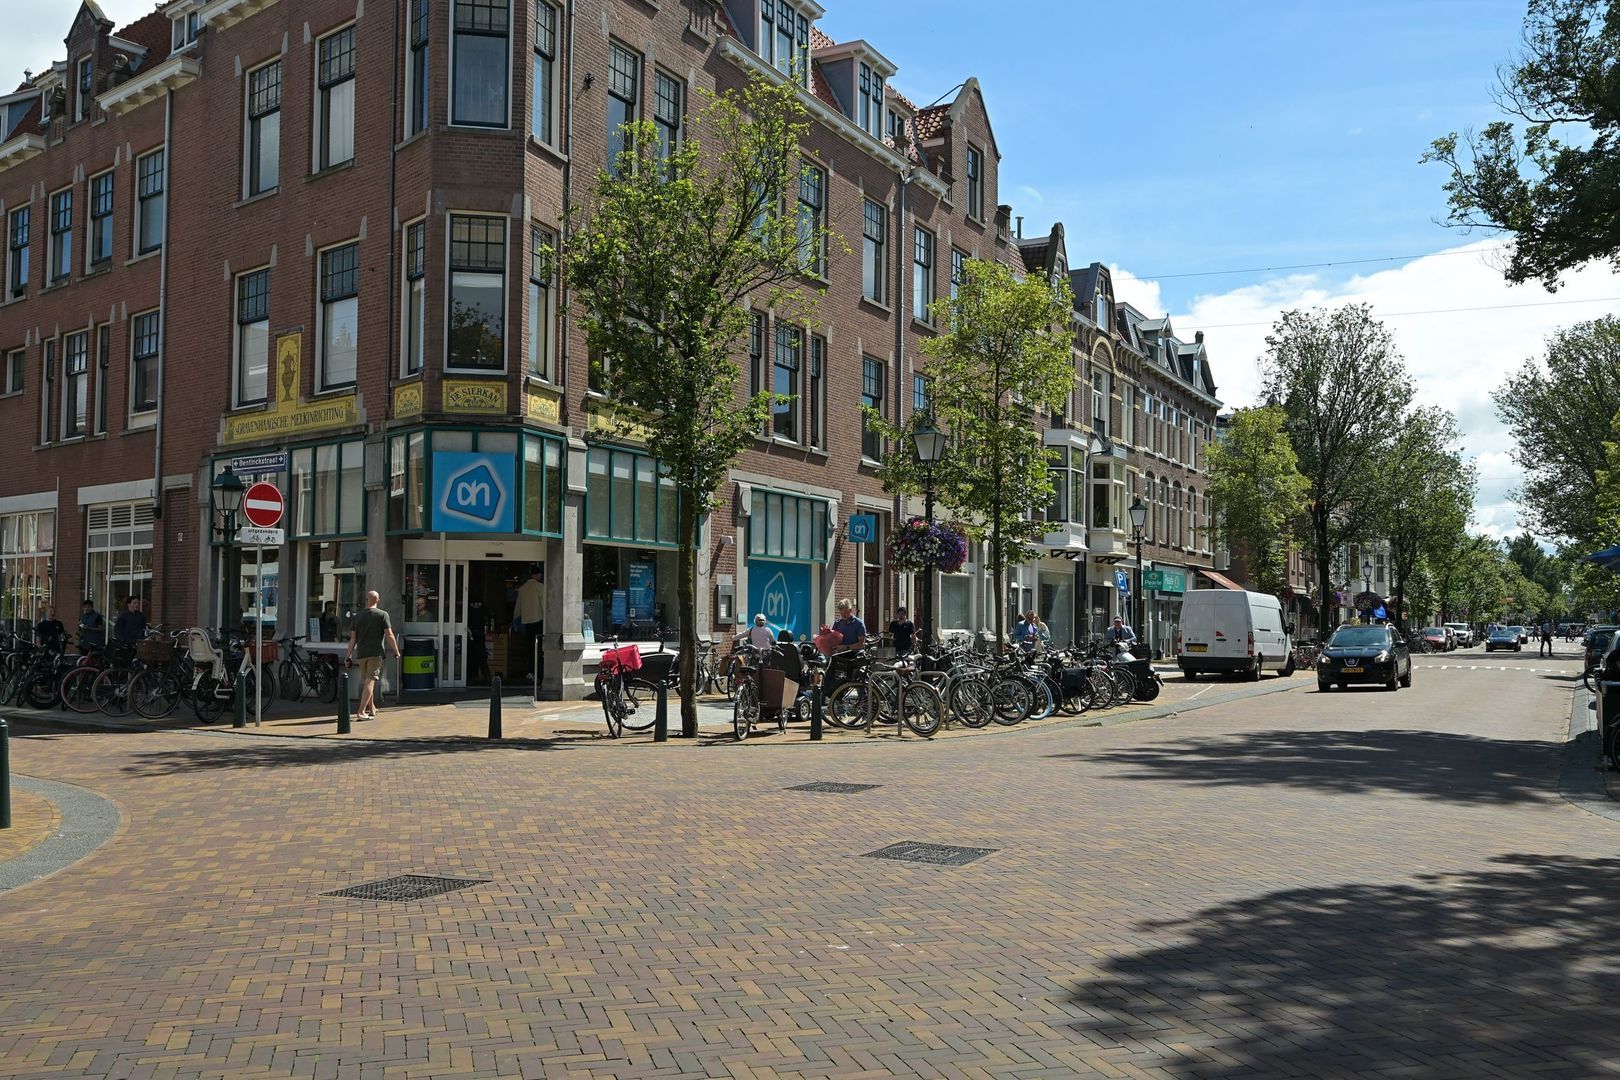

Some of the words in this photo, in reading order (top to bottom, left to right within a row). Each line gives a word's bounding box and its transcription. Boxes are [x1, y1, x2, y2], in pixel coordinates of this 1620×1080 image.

[450, 391, 460, 402] DE
[461, 386, 501, 403] SIERKAN
[290, 406, 344, 426] MELKINRICHTING
[238, 456, 278, 467] Bentinckstraat
